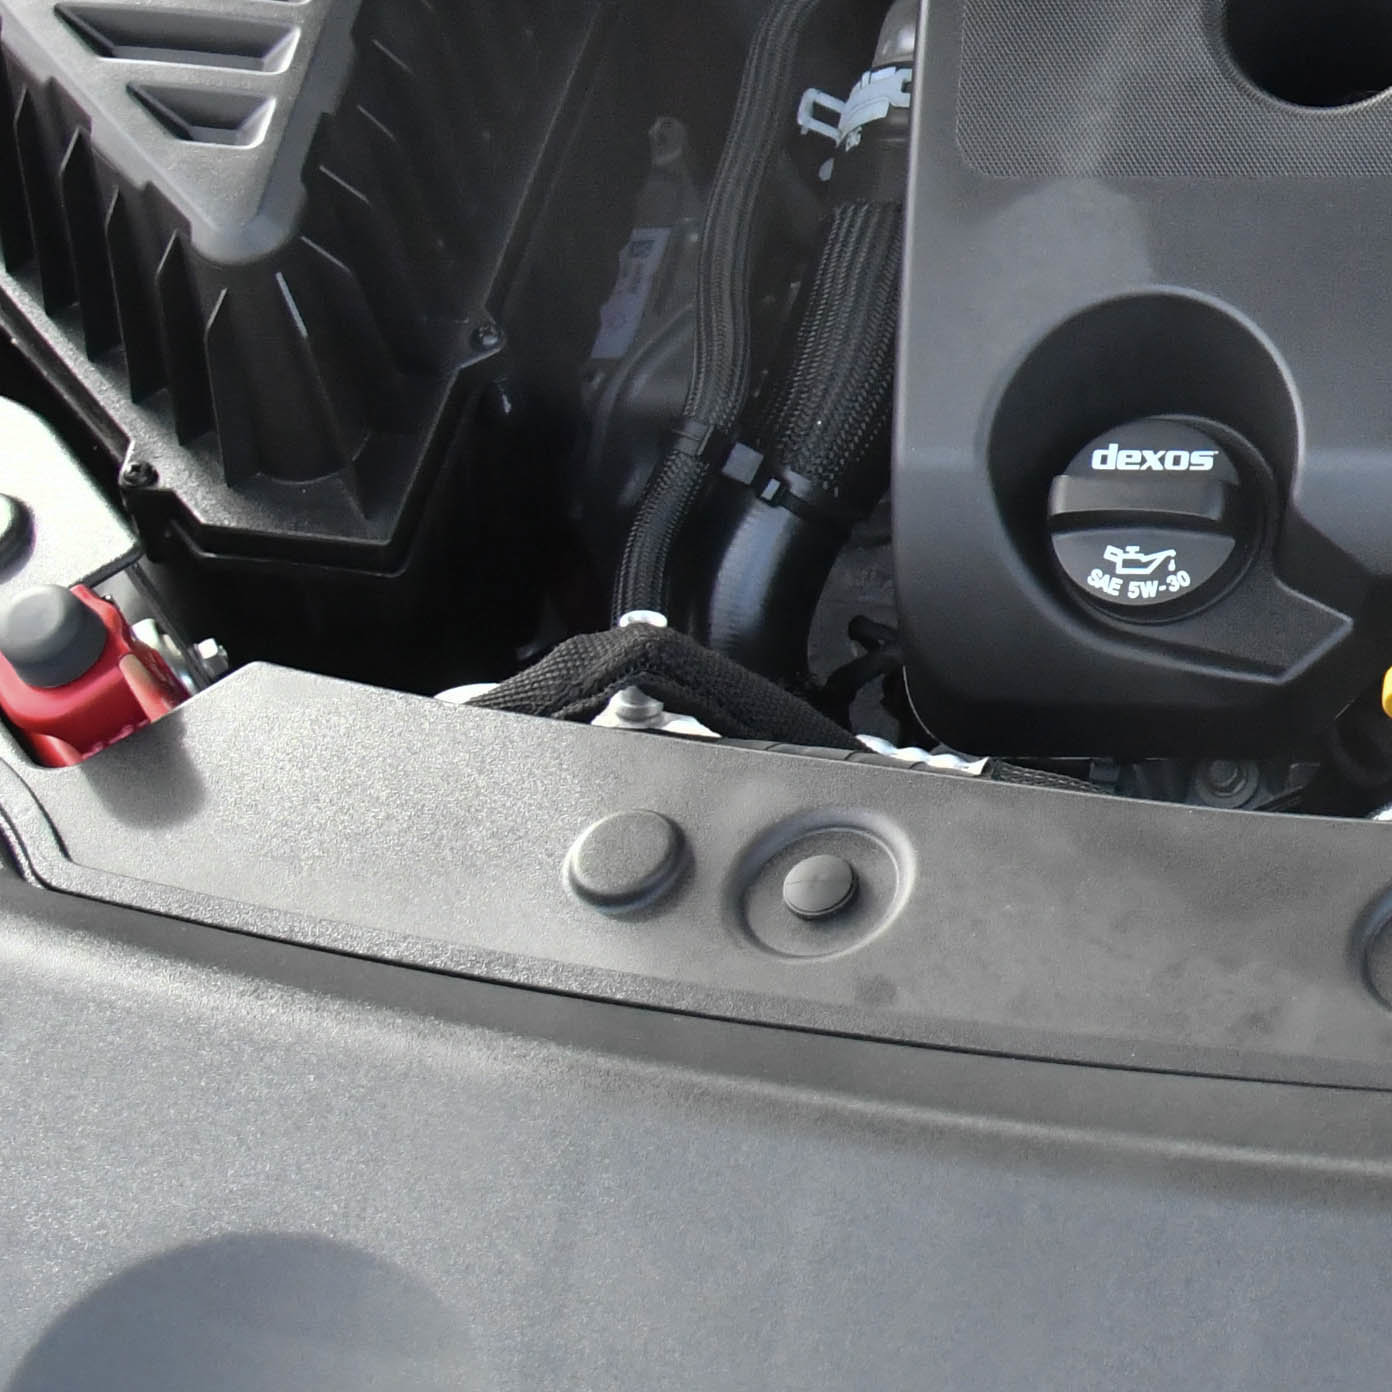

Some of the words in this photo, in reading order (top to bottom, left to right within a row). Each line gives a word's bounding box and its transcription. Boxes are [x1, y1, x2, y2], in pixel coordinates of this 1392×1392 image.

[1091, 443, 1217, 471] dexos
[1087, 568, 1123, 596] SAE
[1127, 570, 1191, 598] 5W-30
